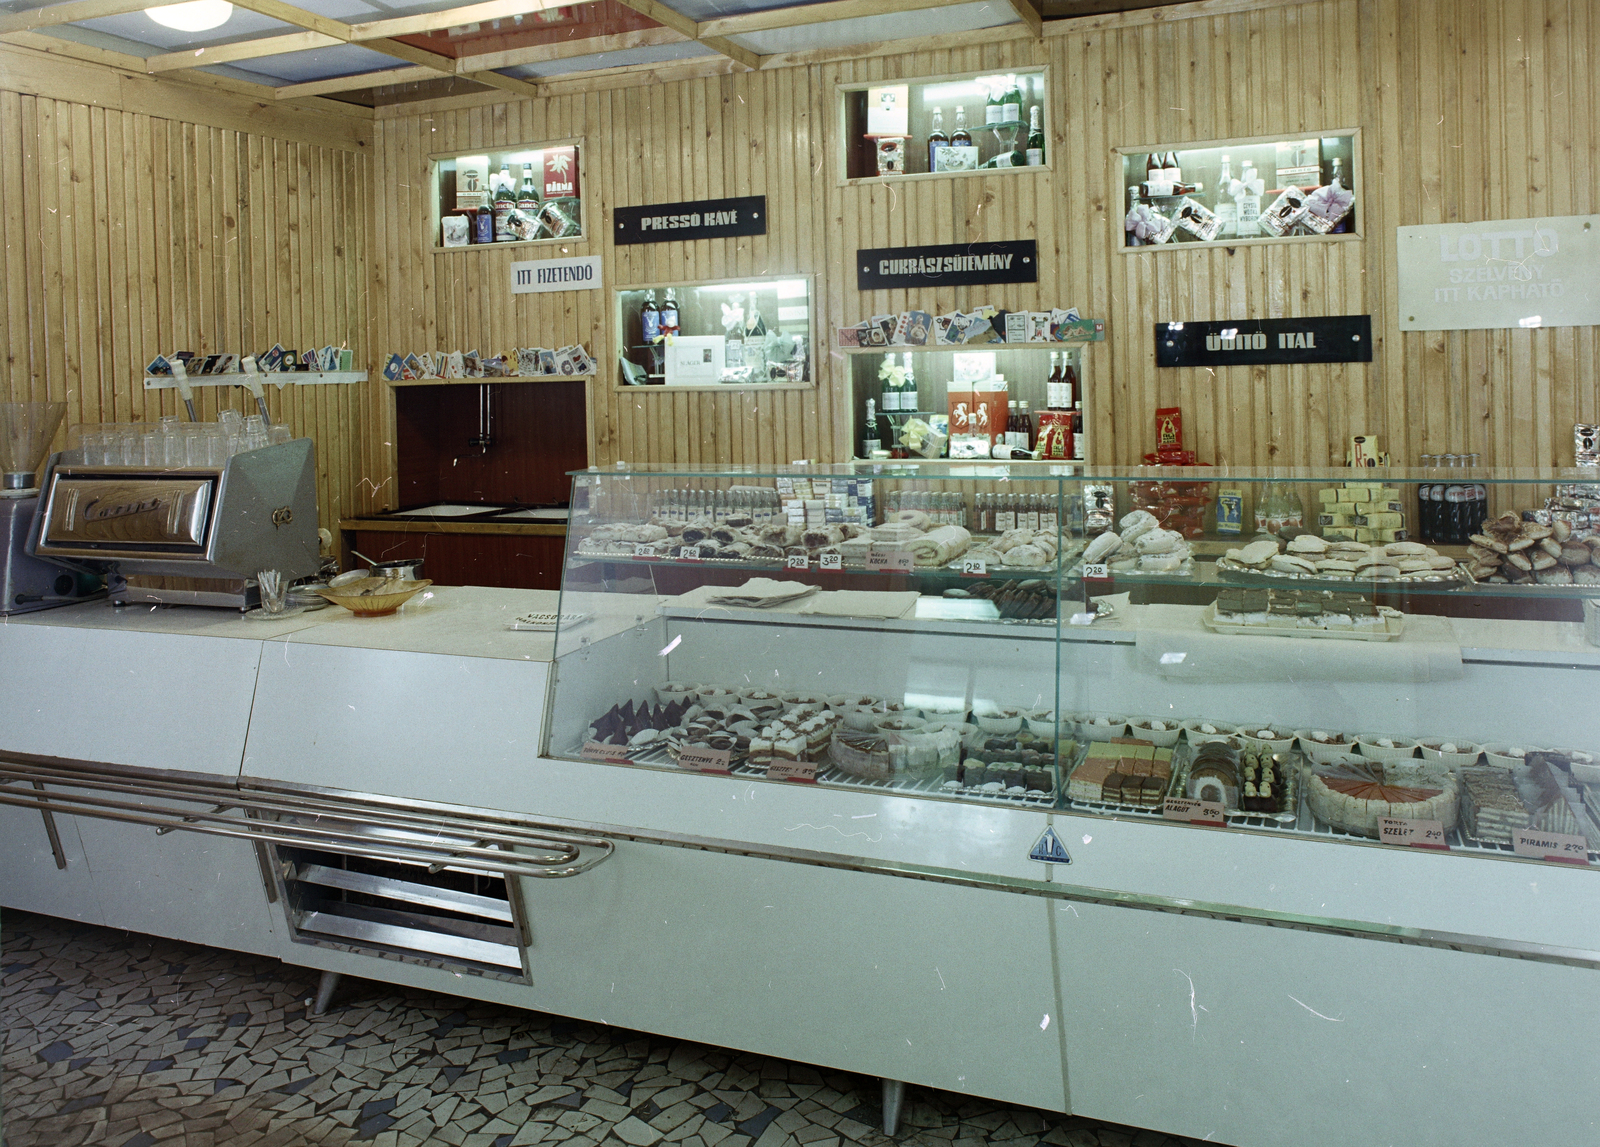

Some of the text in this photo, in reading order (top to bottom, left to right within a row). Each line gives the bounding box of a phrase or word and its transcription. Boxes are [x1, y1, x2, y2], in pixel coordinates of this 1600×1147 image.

[641, 209, 738, 231] PRESSÓ KÁVÉ
[1439, 228, 1559, 262] LOTTO
[879, 252, 1013, 275] CUKRÁSZSÜTEMÉNY
[1450, 262, 1545, 284] SZELVÉNY
[517, 269, 532, 285] ITT
[1434, 278, 1565, 302] ITT KAPHATÓ
[1278, 332, 1317, 349] ITAL
[1520, 837, 1558, 849] PIRAMIS
